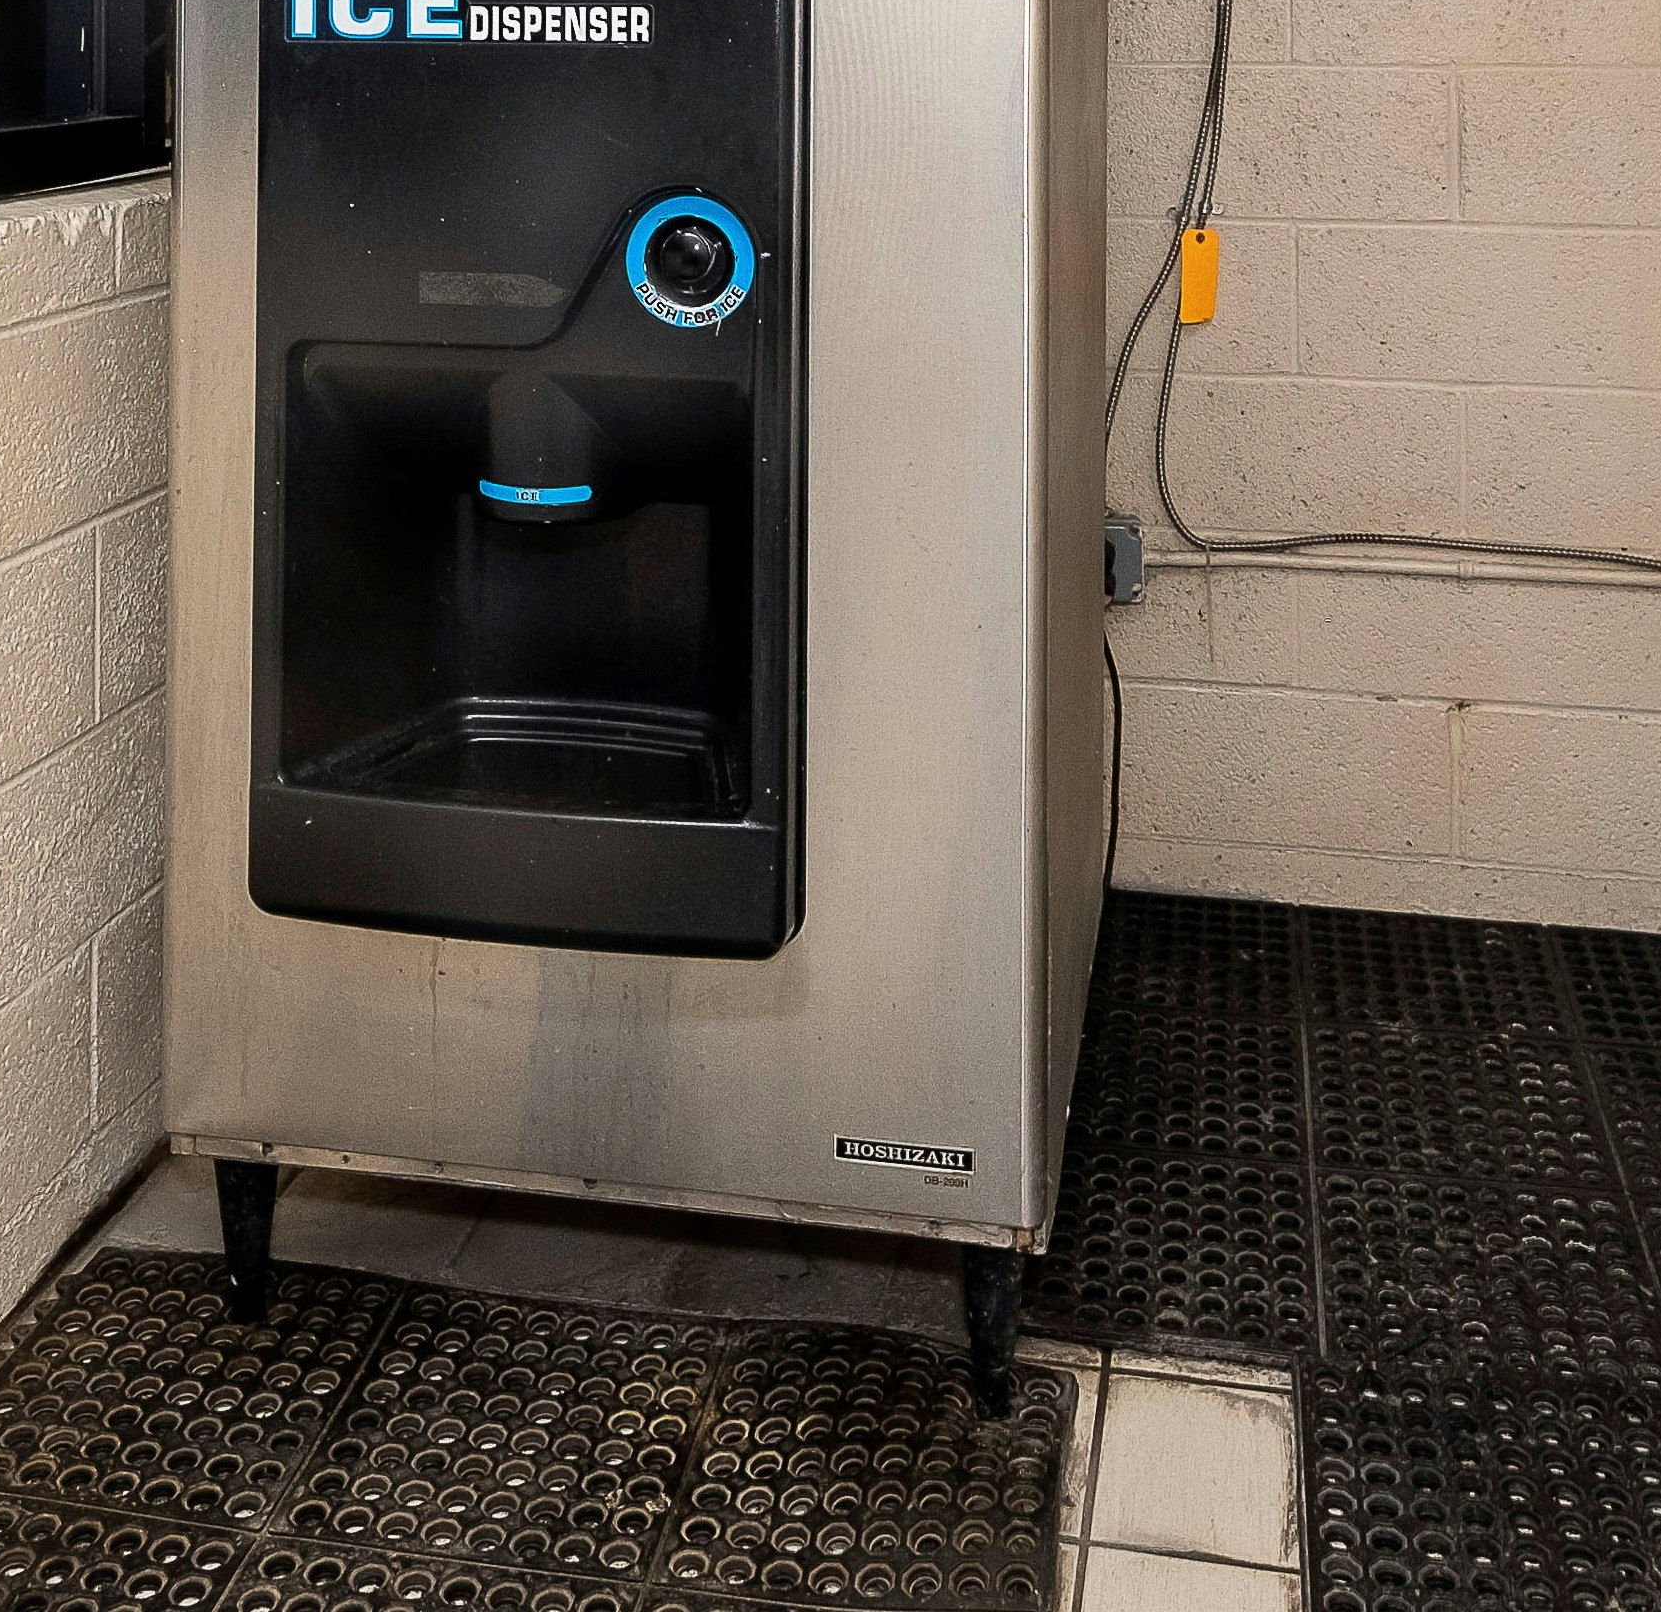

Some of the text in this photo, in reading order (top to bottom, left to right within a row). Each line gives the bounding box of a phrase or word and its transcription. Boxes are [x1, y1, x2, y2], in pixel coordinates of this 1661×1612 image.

[469, 5, 650, 42] DISPENSER
[636, 282, 744, 324] PUSH FOR ICE
[844, 1141, 965, 1167] HOSHIZAKI
